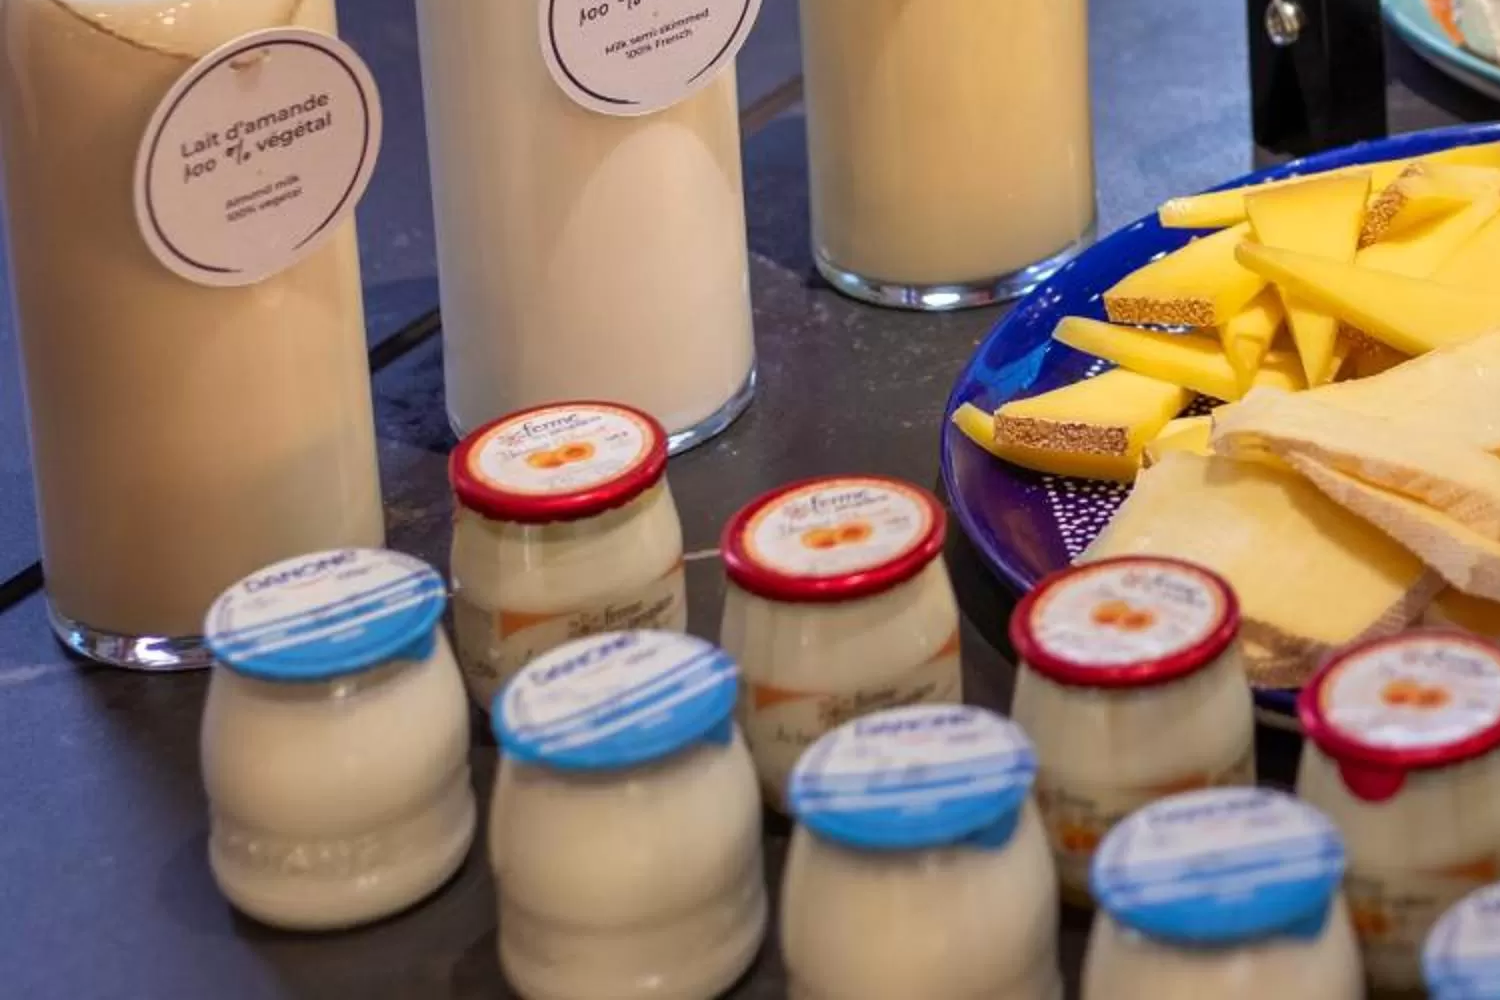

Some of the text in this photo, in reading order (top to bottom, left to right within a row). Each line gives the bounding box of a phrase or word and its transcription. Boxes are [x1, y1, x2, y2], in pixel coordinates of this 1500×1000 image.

[180, 92, 330, 158] Lait d'amande
[256, 111, 332, 152] végétal
[243, 550, 357, 594] DANONE
